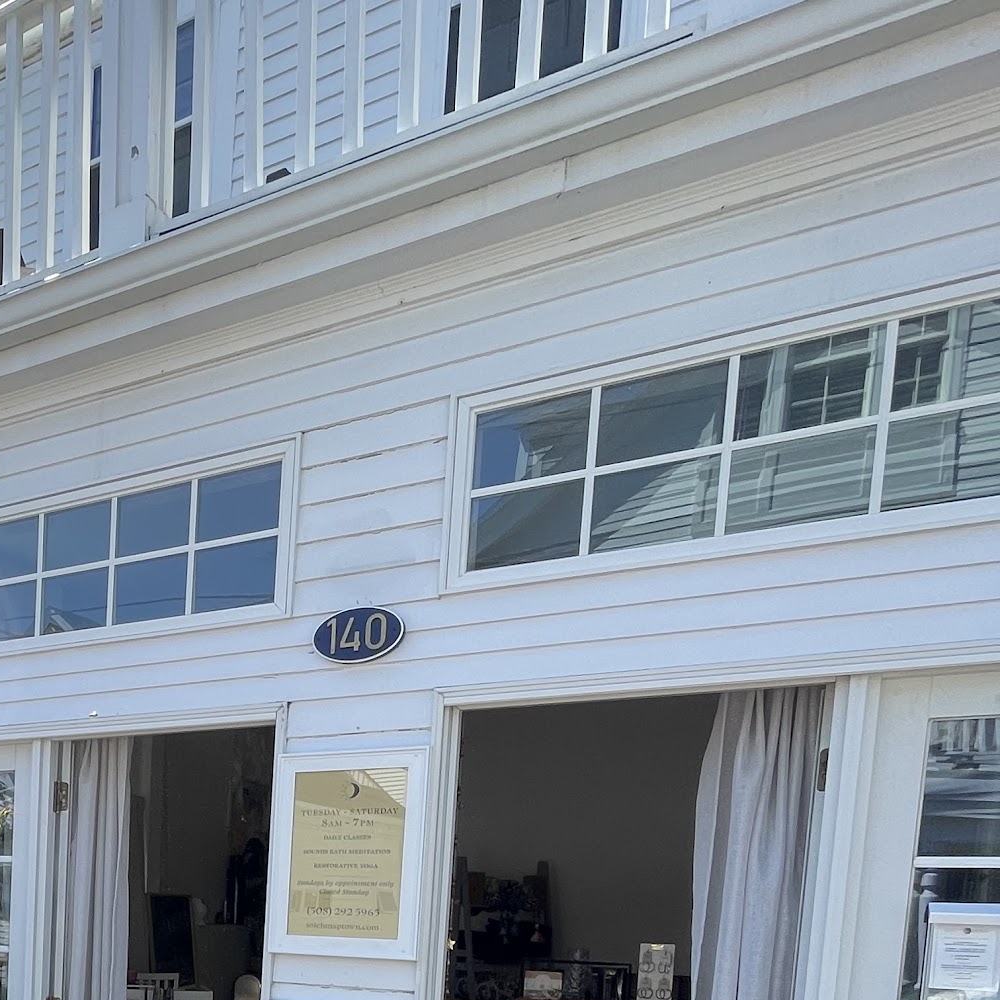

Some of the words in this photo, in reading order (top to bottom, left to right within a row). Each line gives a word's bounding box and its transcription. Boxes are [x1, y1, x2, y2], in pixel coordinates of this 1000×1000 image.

[326, 612, 387, 655] 140
[301, 809, 341, 817] TUESDAY
[349, 807, 399, 815] SATURDAY
[352, 818, 374, 827] 7PM
[334, 907, 353, 917] 292
